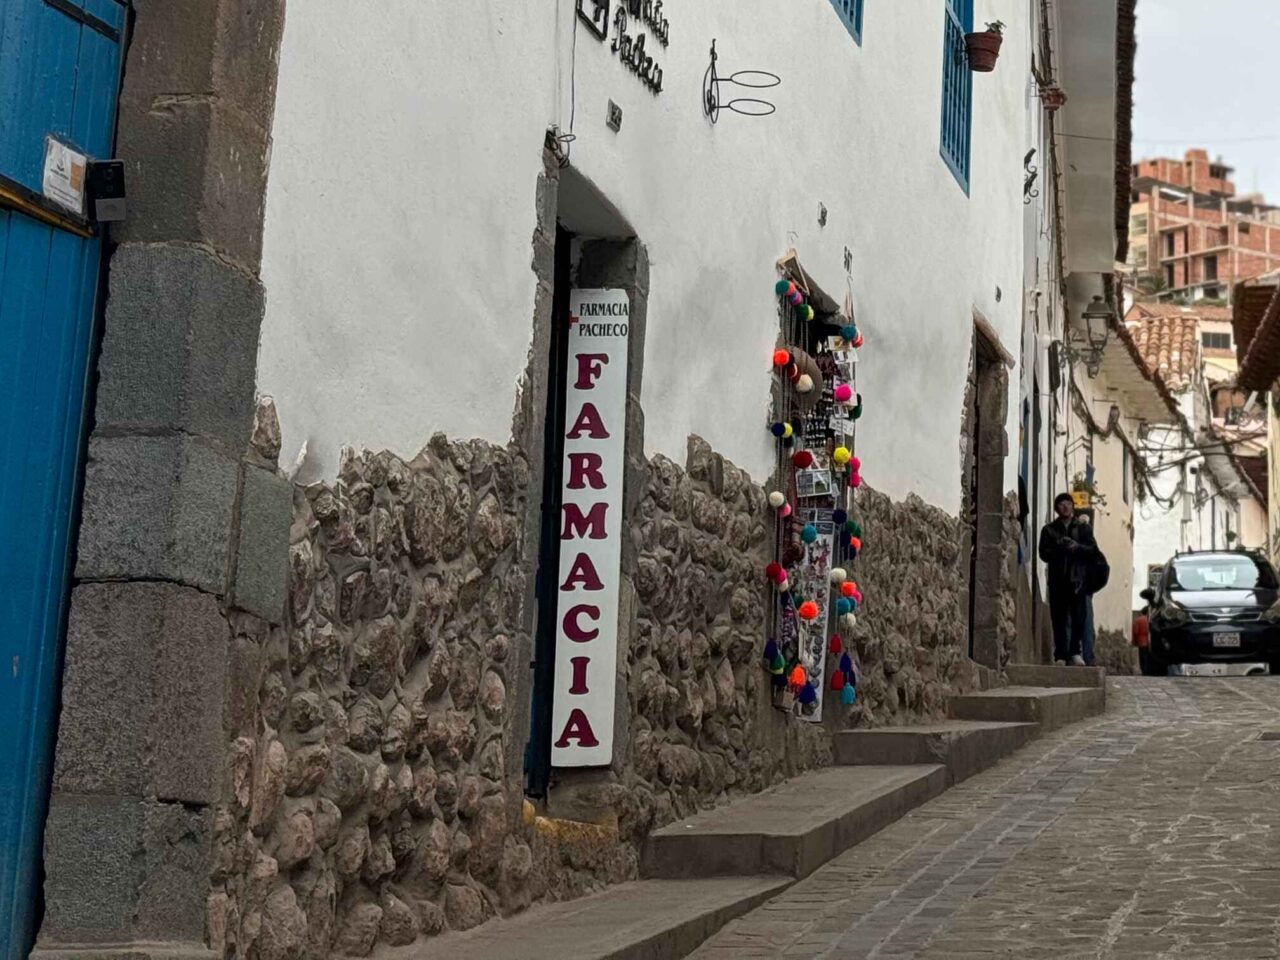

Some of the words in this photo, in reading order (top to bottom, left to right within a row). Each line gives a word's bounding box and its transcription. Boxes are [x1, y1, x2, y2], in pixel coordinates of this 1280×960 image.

[579, 303, 628, 317] FARMACIA
[579, 323, 628, 337] PACHECO
[554, 353, 610, 749] FARMACIA
